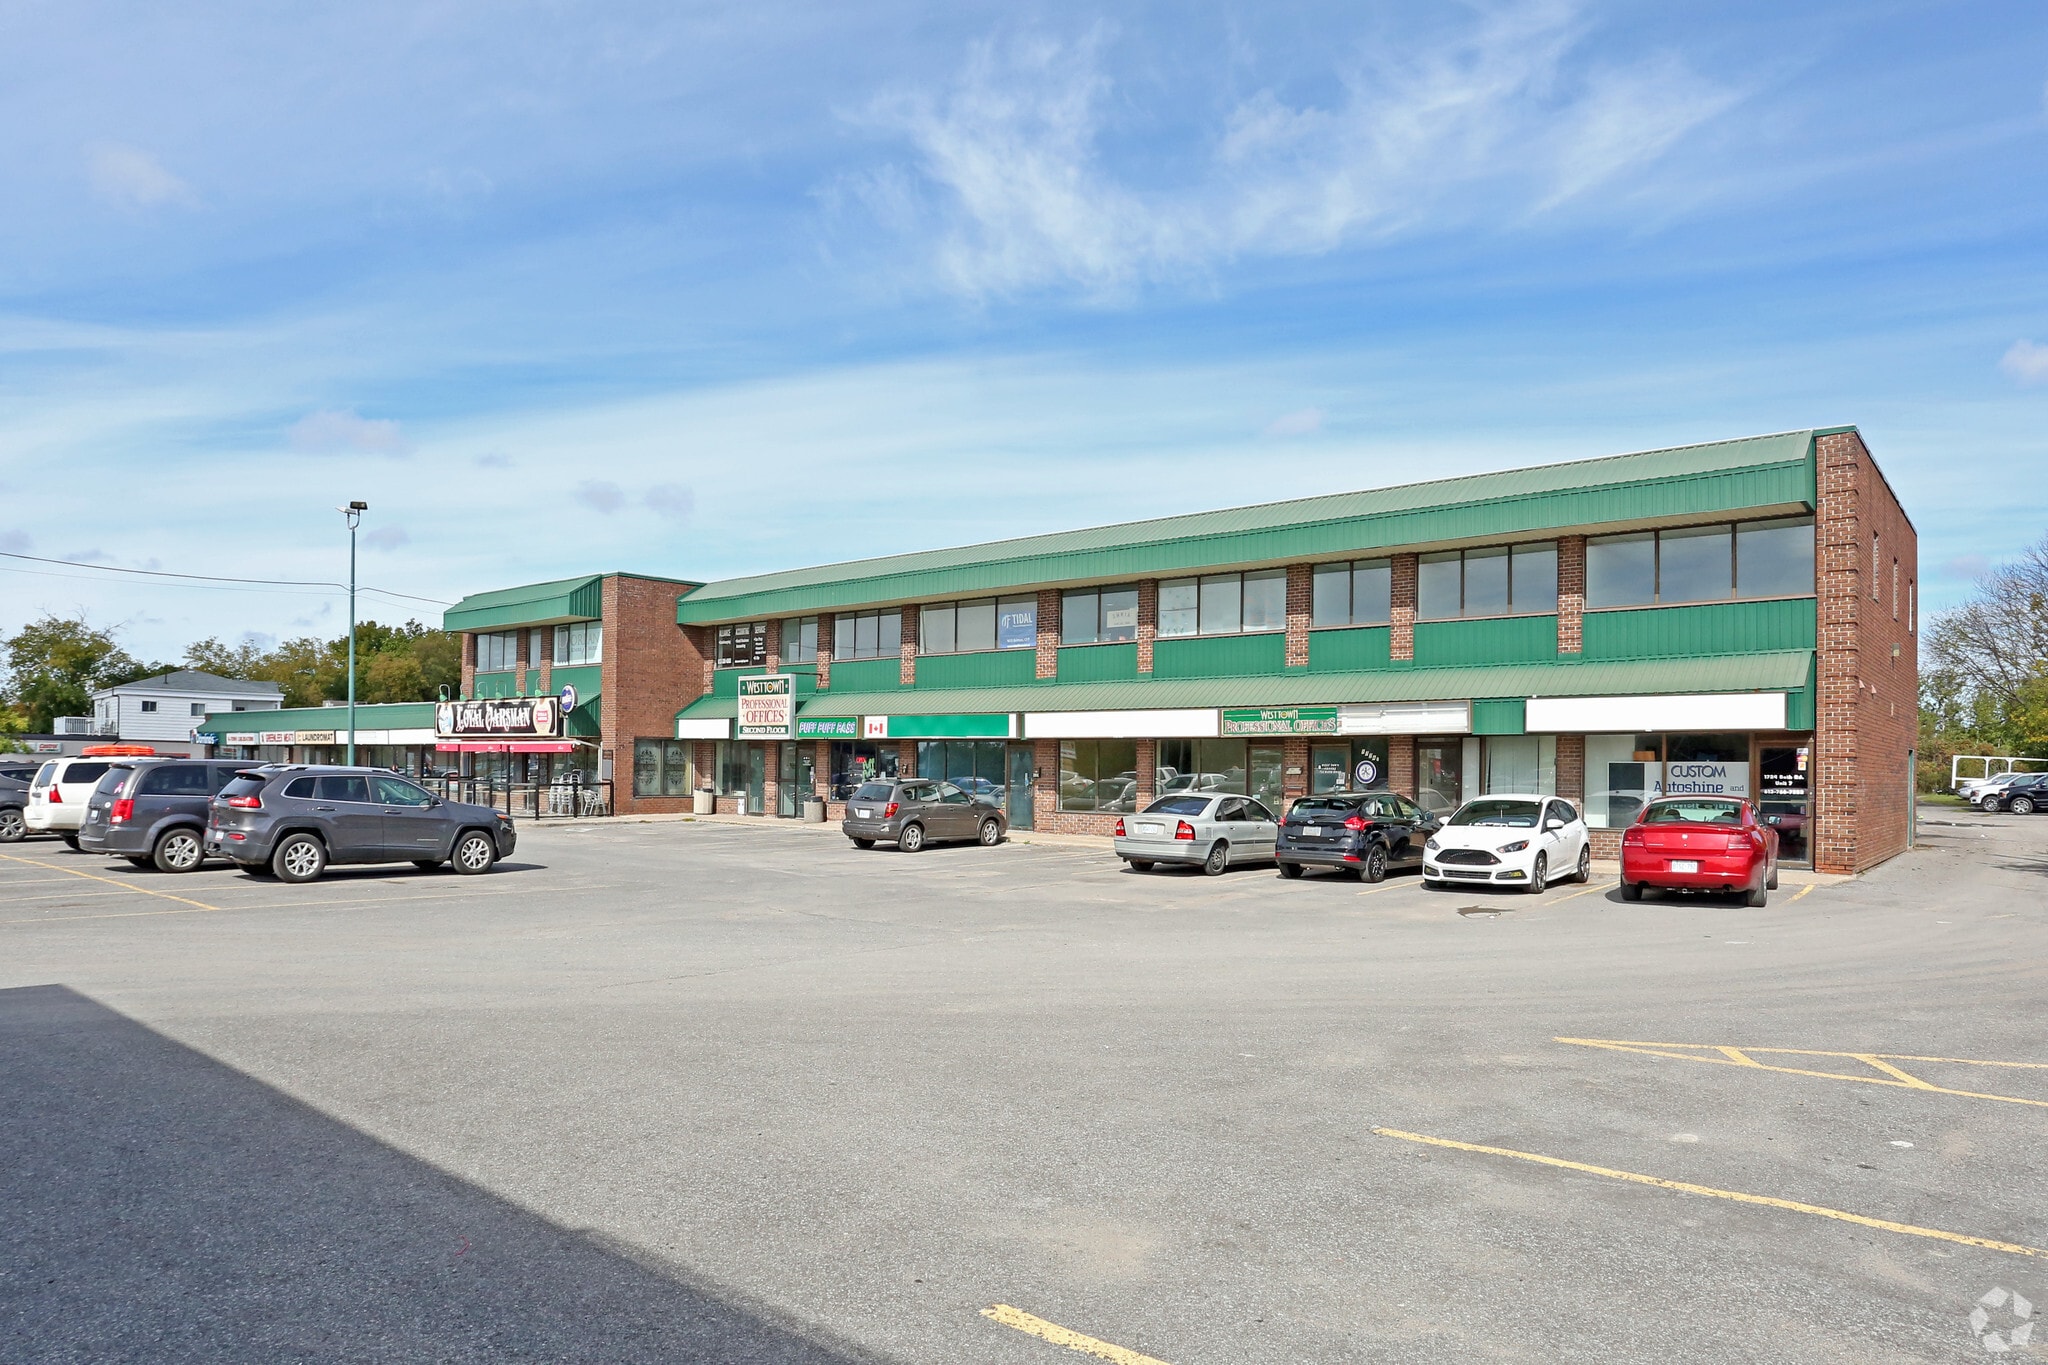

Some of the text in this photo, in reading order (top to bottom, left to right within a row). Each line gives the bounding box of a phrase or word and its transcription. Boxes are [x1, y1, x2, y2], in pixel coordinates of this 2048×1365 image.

[1012, 613, 1033, 625] TIDAL
[741, 698, 789, 710] PROFESSIONAL
[746, 710, 785, 723] OFFICES
[766, 726, 786, 734] FLOOR
[799, 721, 856, 734] PUFF PUFF PASS
[1224, 717, 1337, 733] PROFESSIONAL OFFICES
[303, 733, 333, 741] LAUNDROMAT
[1670, 765, 1727, 778] CUSTOM
